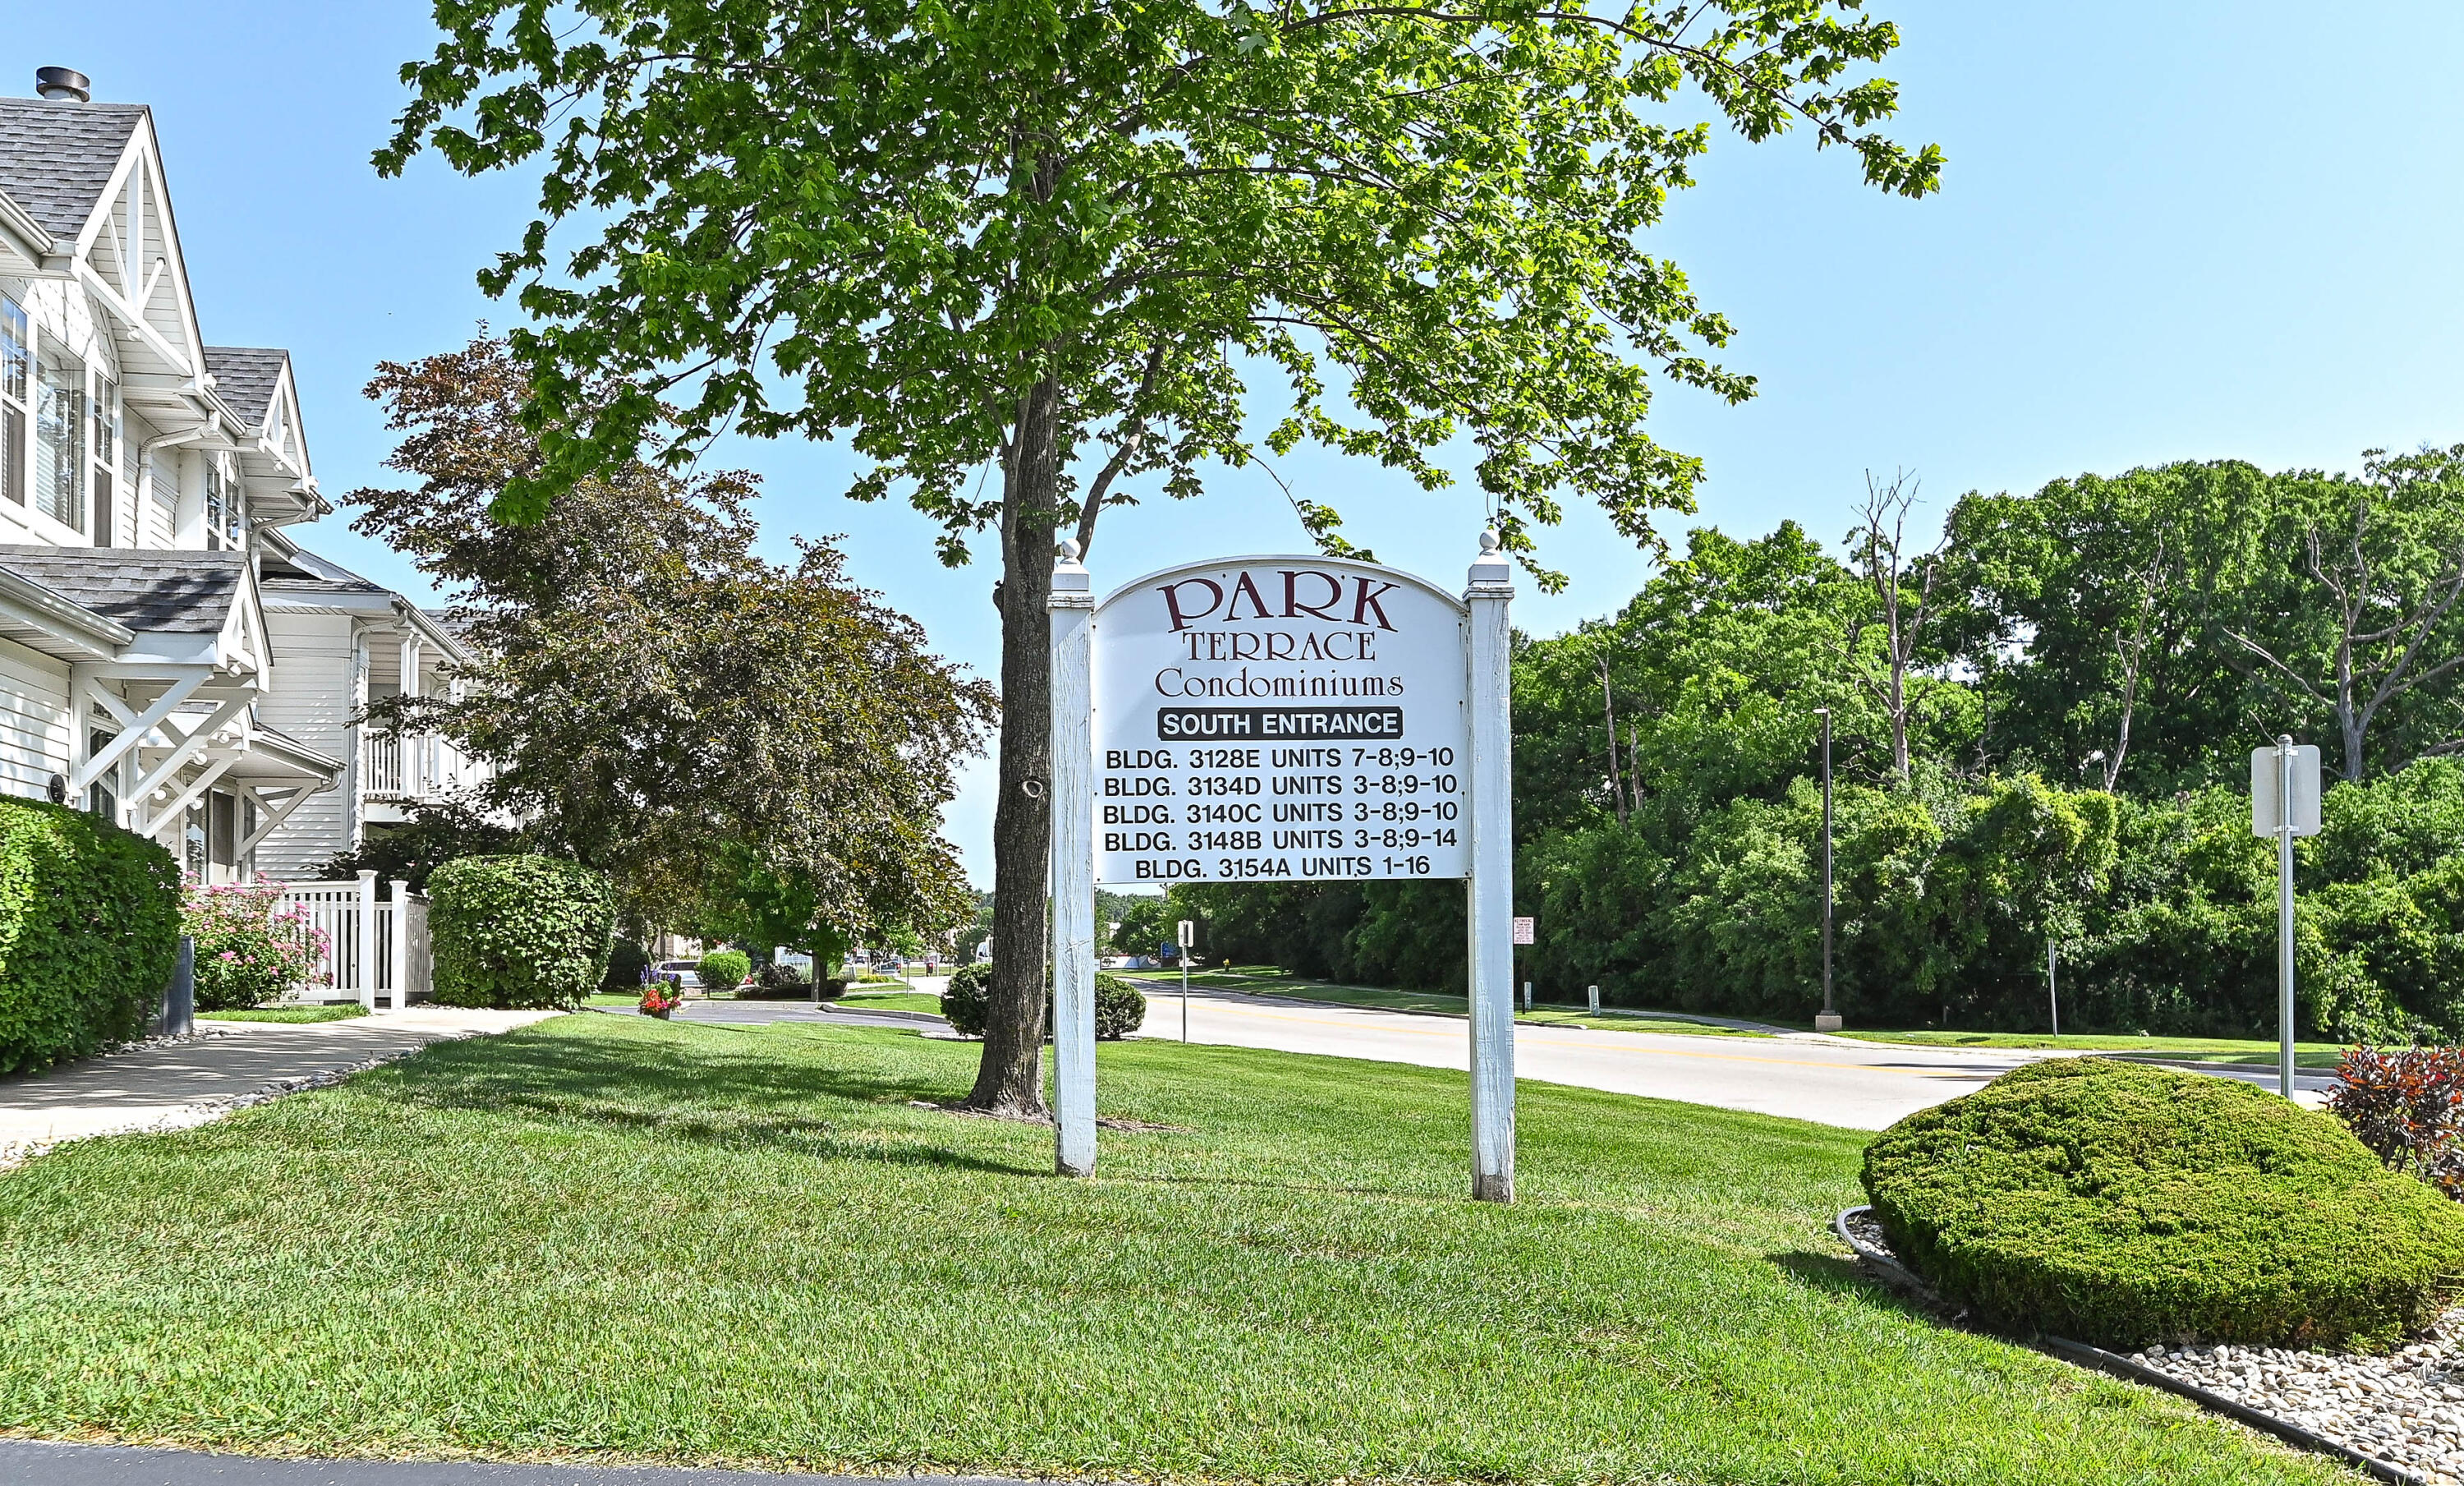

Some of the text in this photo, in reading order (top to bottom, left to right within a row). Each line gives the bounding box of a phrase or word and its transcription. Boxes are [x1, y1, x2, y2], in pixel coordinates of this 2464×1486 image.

[1156, 570, 1401, 634] PARK
[1183, 631, 1376, 661] TERRACE
[1156, 667, 1404, 697] Condominiums
[1162, 712, 1398, 735] SOUTH ENTRANCE
[1106, 748, 1455, 770] BLDG. 3128E UNITS 7-8;9-10
[1105, 774, 1458, 798] BLDG. 3134D UNITS 3-8;9-10
[1104, 801, 1459, 825] BLDG. 3140C UNITS 3-8;9-10
[1105, 828, 1458, 852] BLDG. 3148B UNITS 3-8;9-14
[1135, 855, 1431, 879] BLDG. 3154A UNITS 1-16
